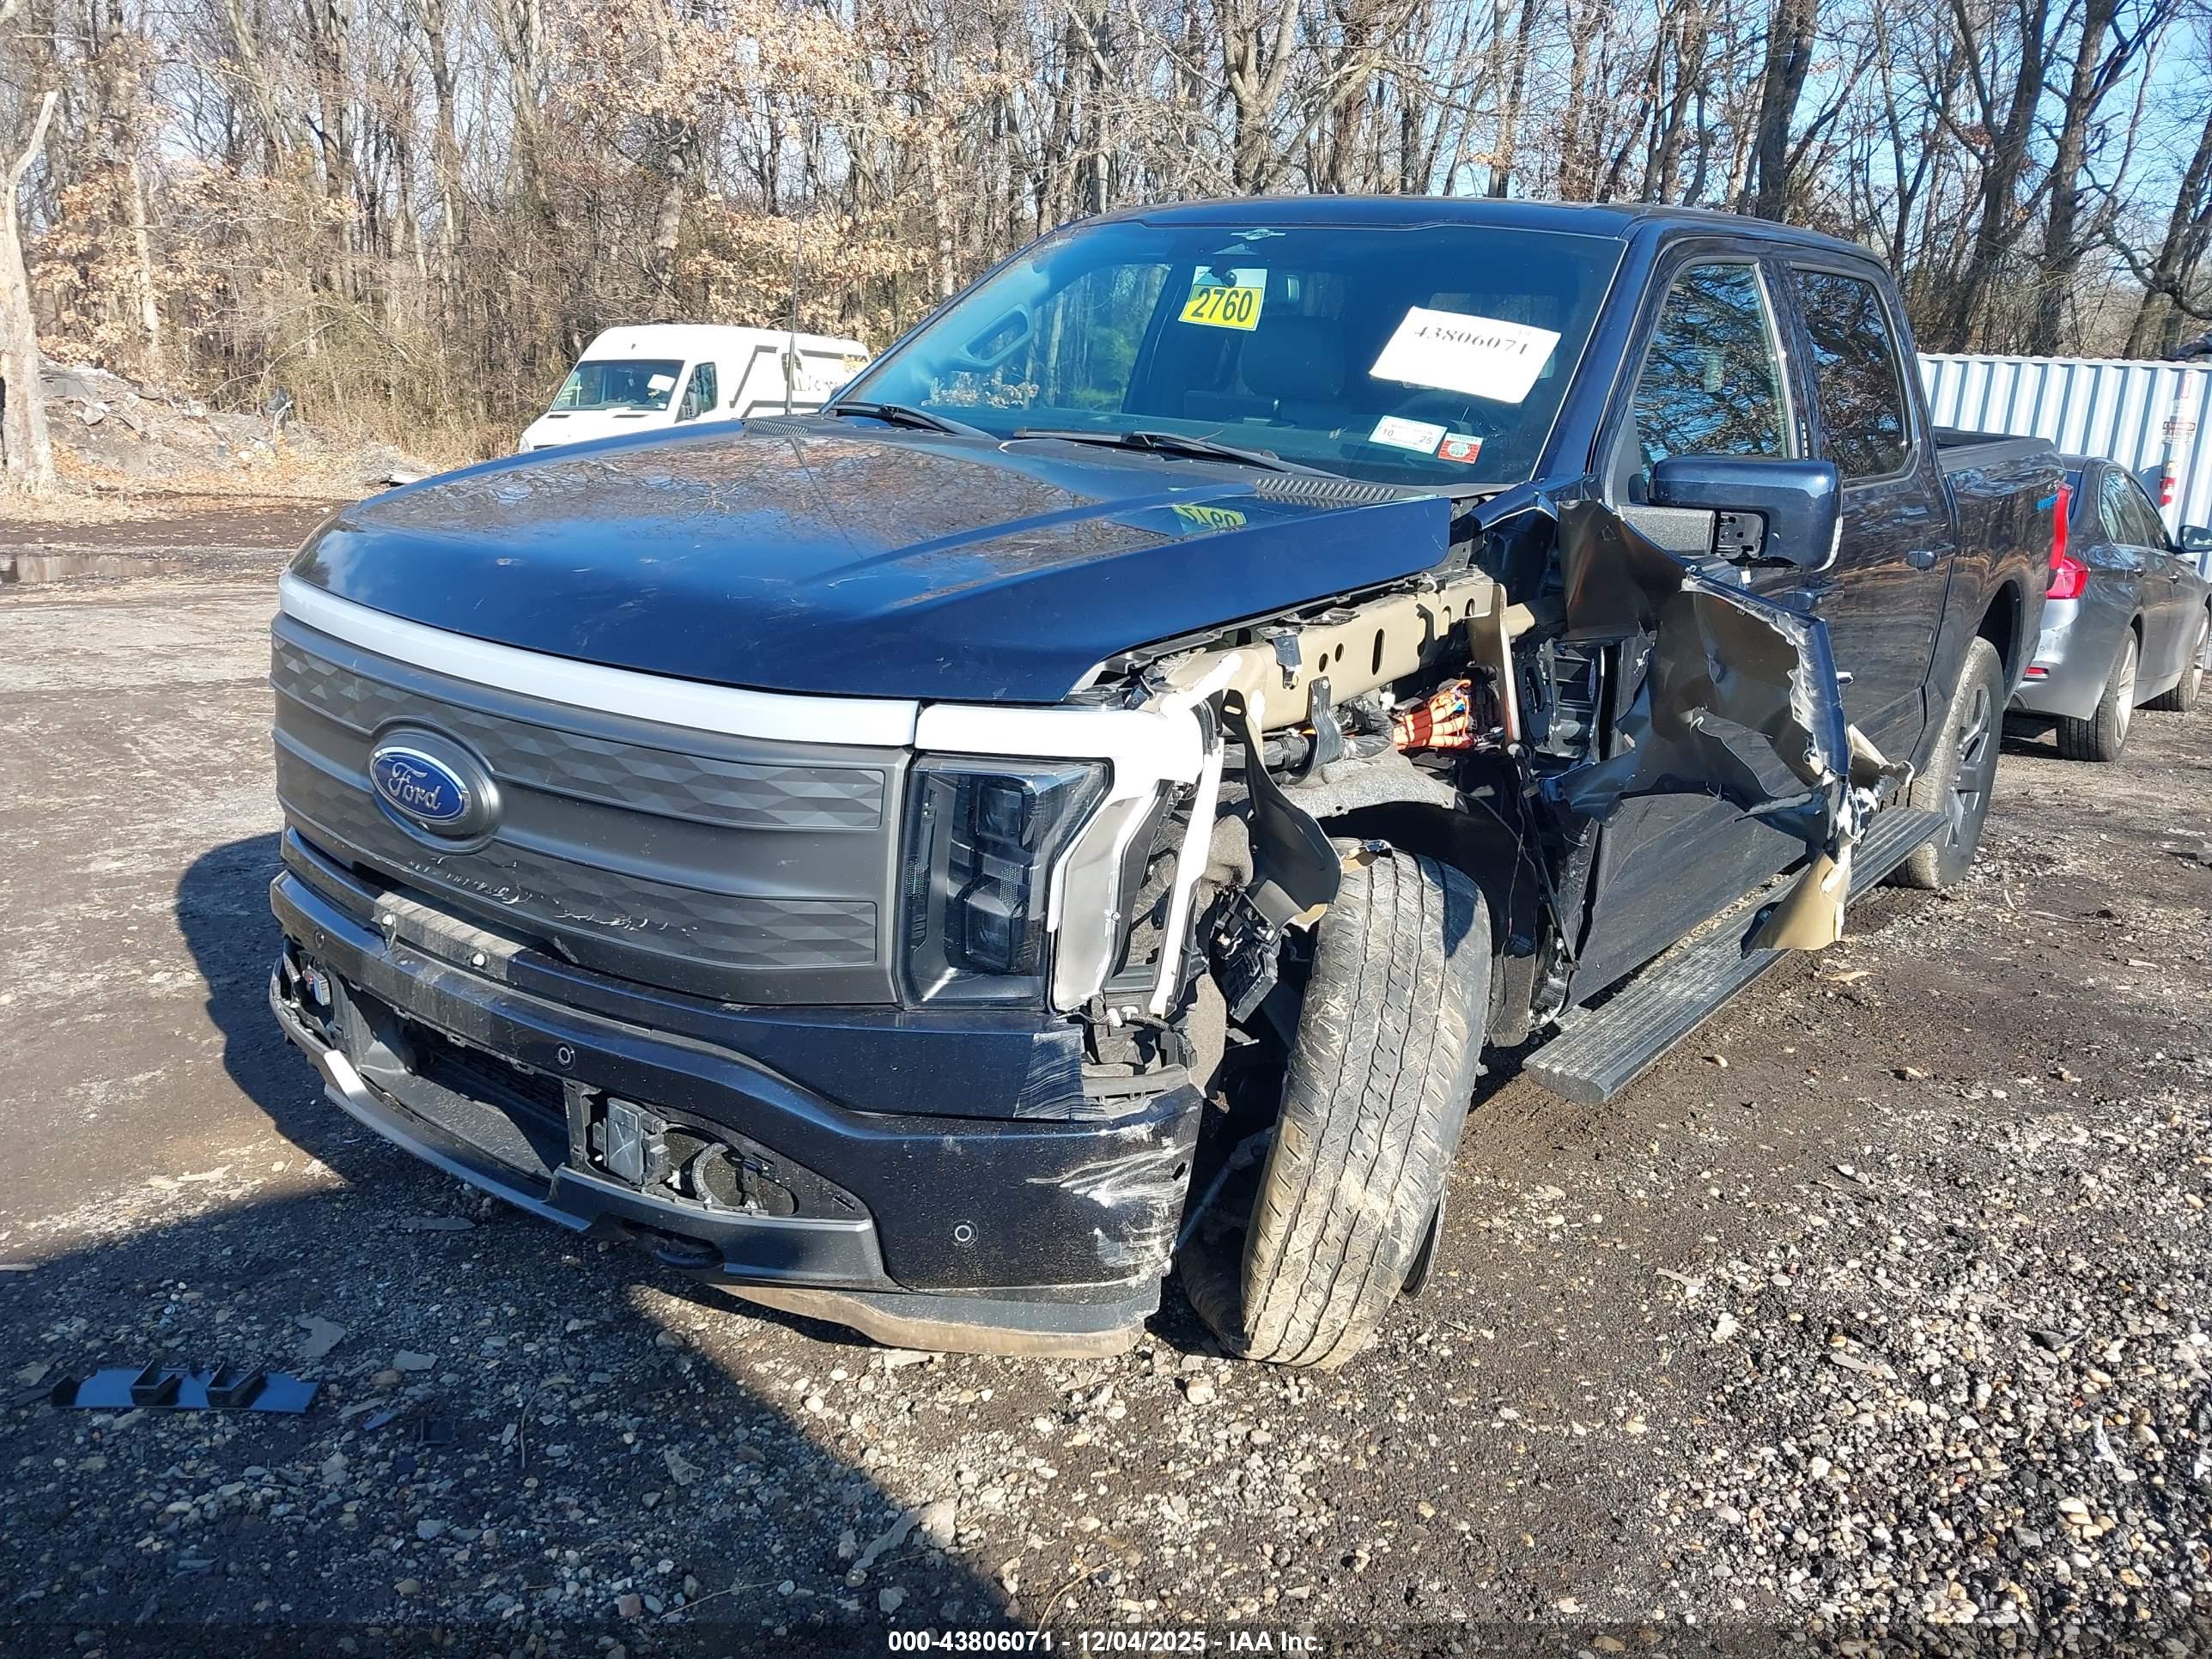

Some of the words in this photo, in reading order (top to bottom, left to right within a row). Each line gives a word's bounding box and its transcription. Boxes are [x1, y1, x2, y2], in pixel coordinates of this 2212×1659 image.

[1191, 287, 1254, 323] 2760
[1414, 325, 1528, 355] 43806071
[1419, 435, 1434, 445] 25
[388, 762, 442, 811] Ford
